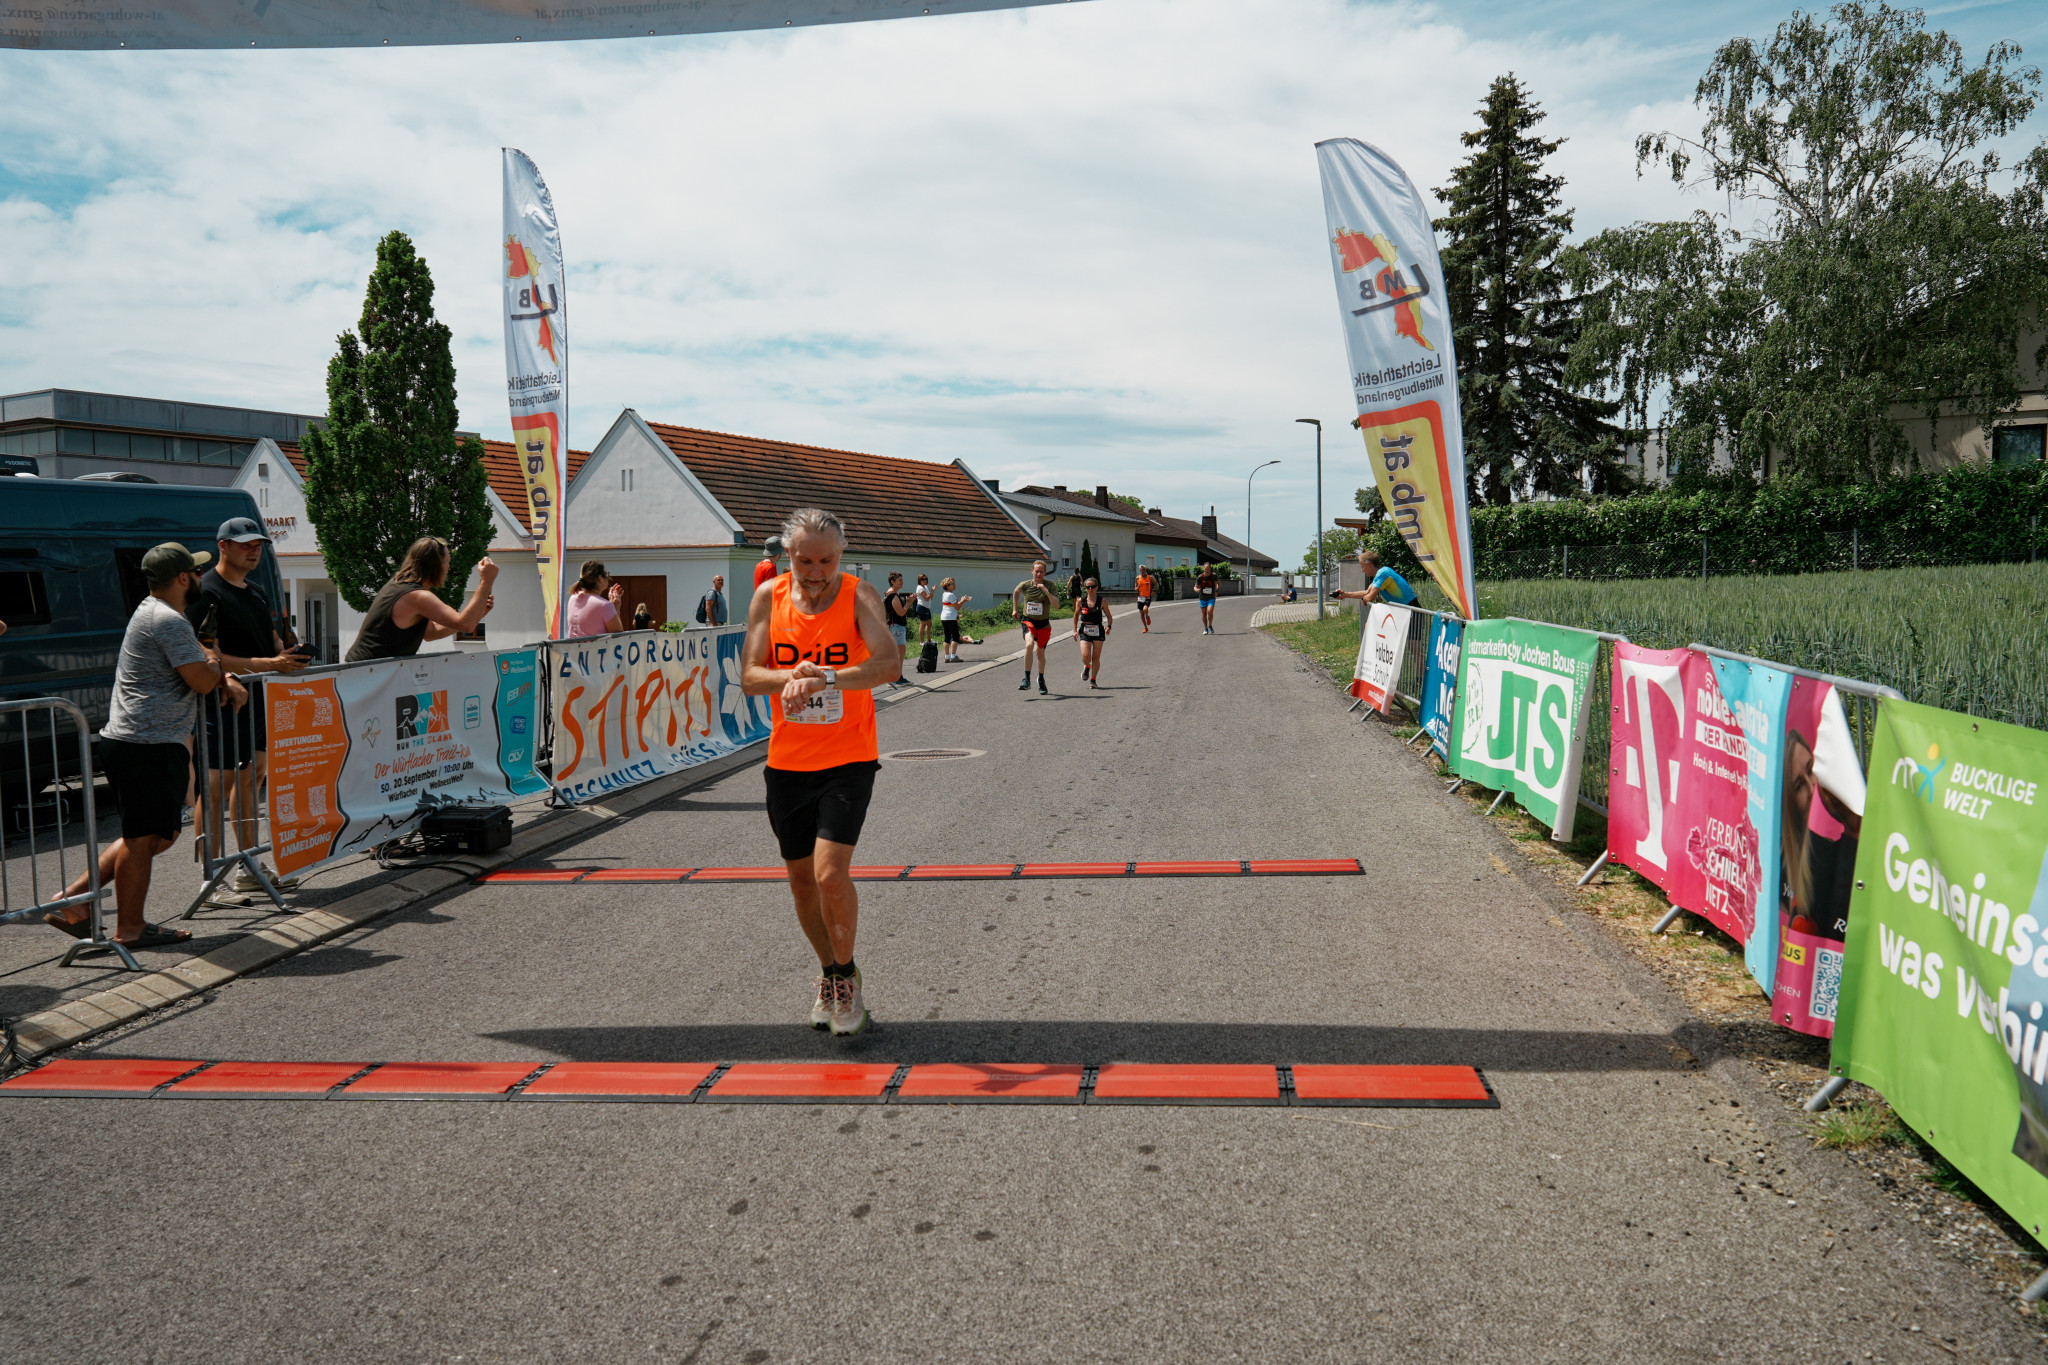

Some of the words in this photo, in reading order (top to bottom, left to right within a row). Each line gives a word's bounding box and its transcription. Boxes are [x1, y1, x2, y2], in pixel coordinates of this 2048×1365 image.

[264, 516, 296, 527] MARKT
[560, 637, 709, 678] ENTSORGUNG
[1521, 643, 1551, 668] Jochen
[556, 665, 712, 781] STIPITS
[1486, 669, 1568, 789] JTS
[396, 741, 409, 751] RUN
[412, 738, 424, 747] THE
[374, 762, 391, 779] Der
[392, 747, 435, 774] Würflacher
[404, 768, 438, 786] September
[1950, 762, 2038, 806] BUCKLIGE
[1943, 787, 1993, 820] WELT
[278, 829, 298, 844] ZUR
[280, 831, 332, 859] ANMELDUNG
[1879, 922, 1944, 1000] was
